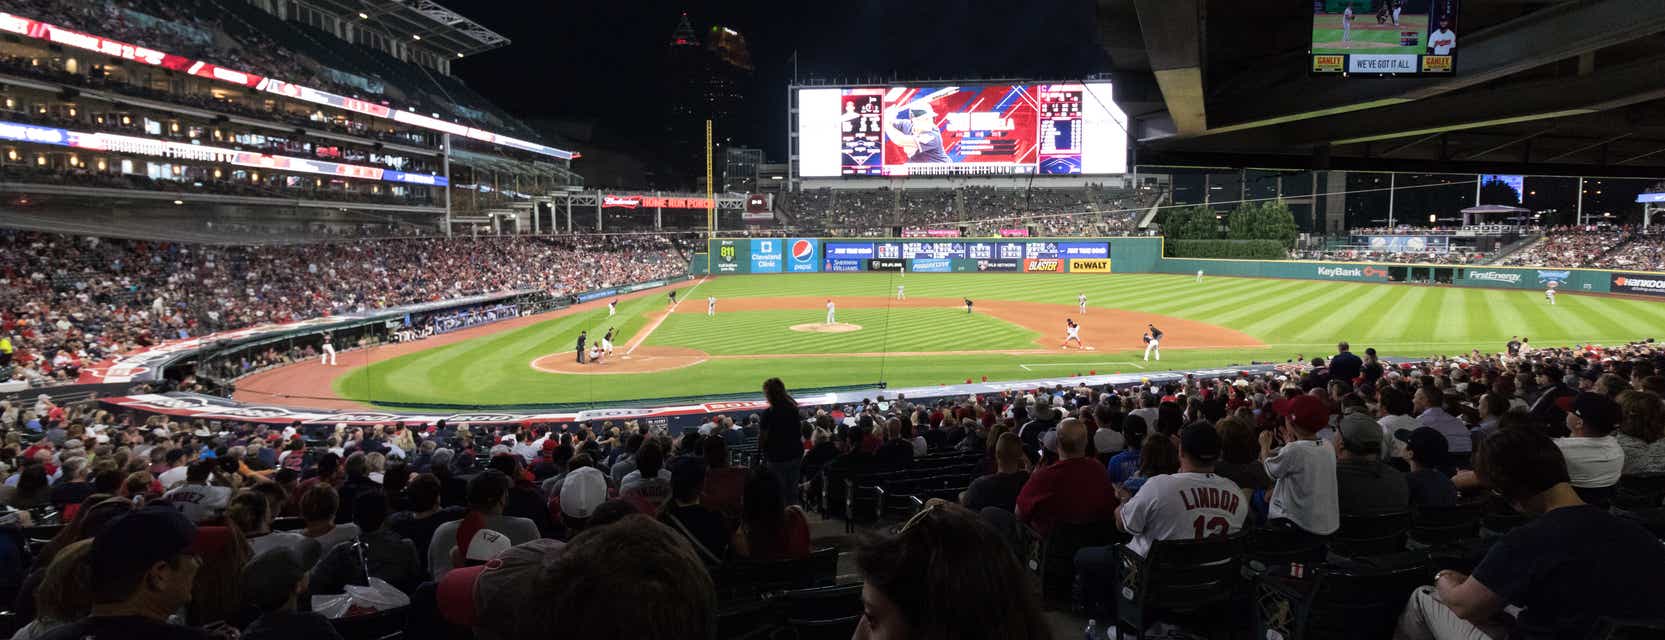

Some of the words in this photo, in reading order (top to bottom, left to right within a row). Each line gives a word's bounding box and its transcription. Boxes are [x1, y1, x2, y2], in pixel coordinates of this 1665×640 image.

[1356, 59, 1377, 69] WE'VE
[1378, 59, 1390, 69] GOT
[1391, 59, 1397, 69] IT
[1398, 59, 1410, 69] ALL
[642, 198, 666, 208] HOME
[669, 198, 686, 208] RUN
[720, 246, 735, 257] 811
[751, 253, 782, 261] Cleveland
[1028, 261, 1058, 271] BLASTER
[1318, 266, 1361, 277] KeyBank
[1470, 271, 1521, 282] FirstEnergy
[1179, 487, 1240, 515] LINDOR
